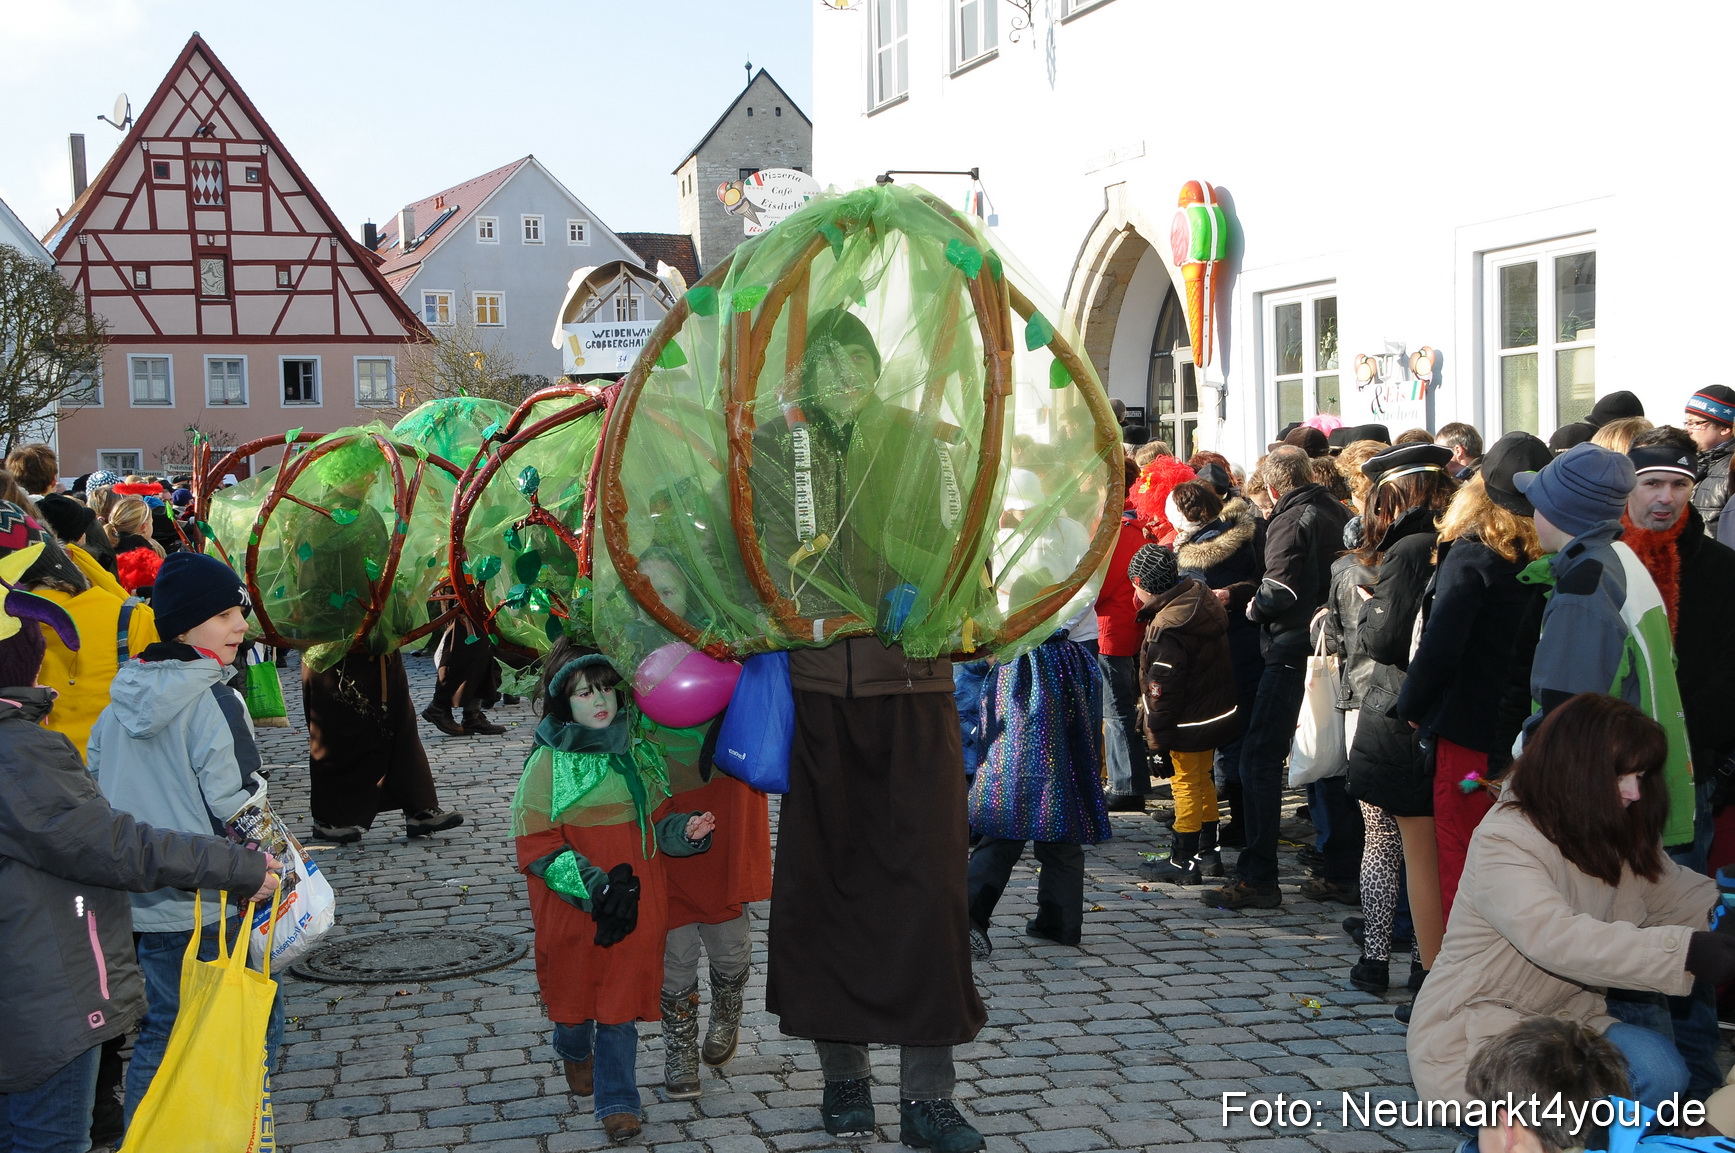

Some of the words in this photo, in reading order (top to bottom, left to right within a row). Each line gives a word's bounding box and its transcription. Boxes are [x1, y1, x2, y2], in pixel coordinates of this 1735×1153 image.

[761, 171, 803, 183] Pizzeria
[771, 186, 793, 196] Café
[760, 198, 803, 210] Eisdiele
[592, 327, 653, 339] WEIDENWAN
[1371, 384, 1386, 415] &
[1385, 385, 1406, 403] Eis
